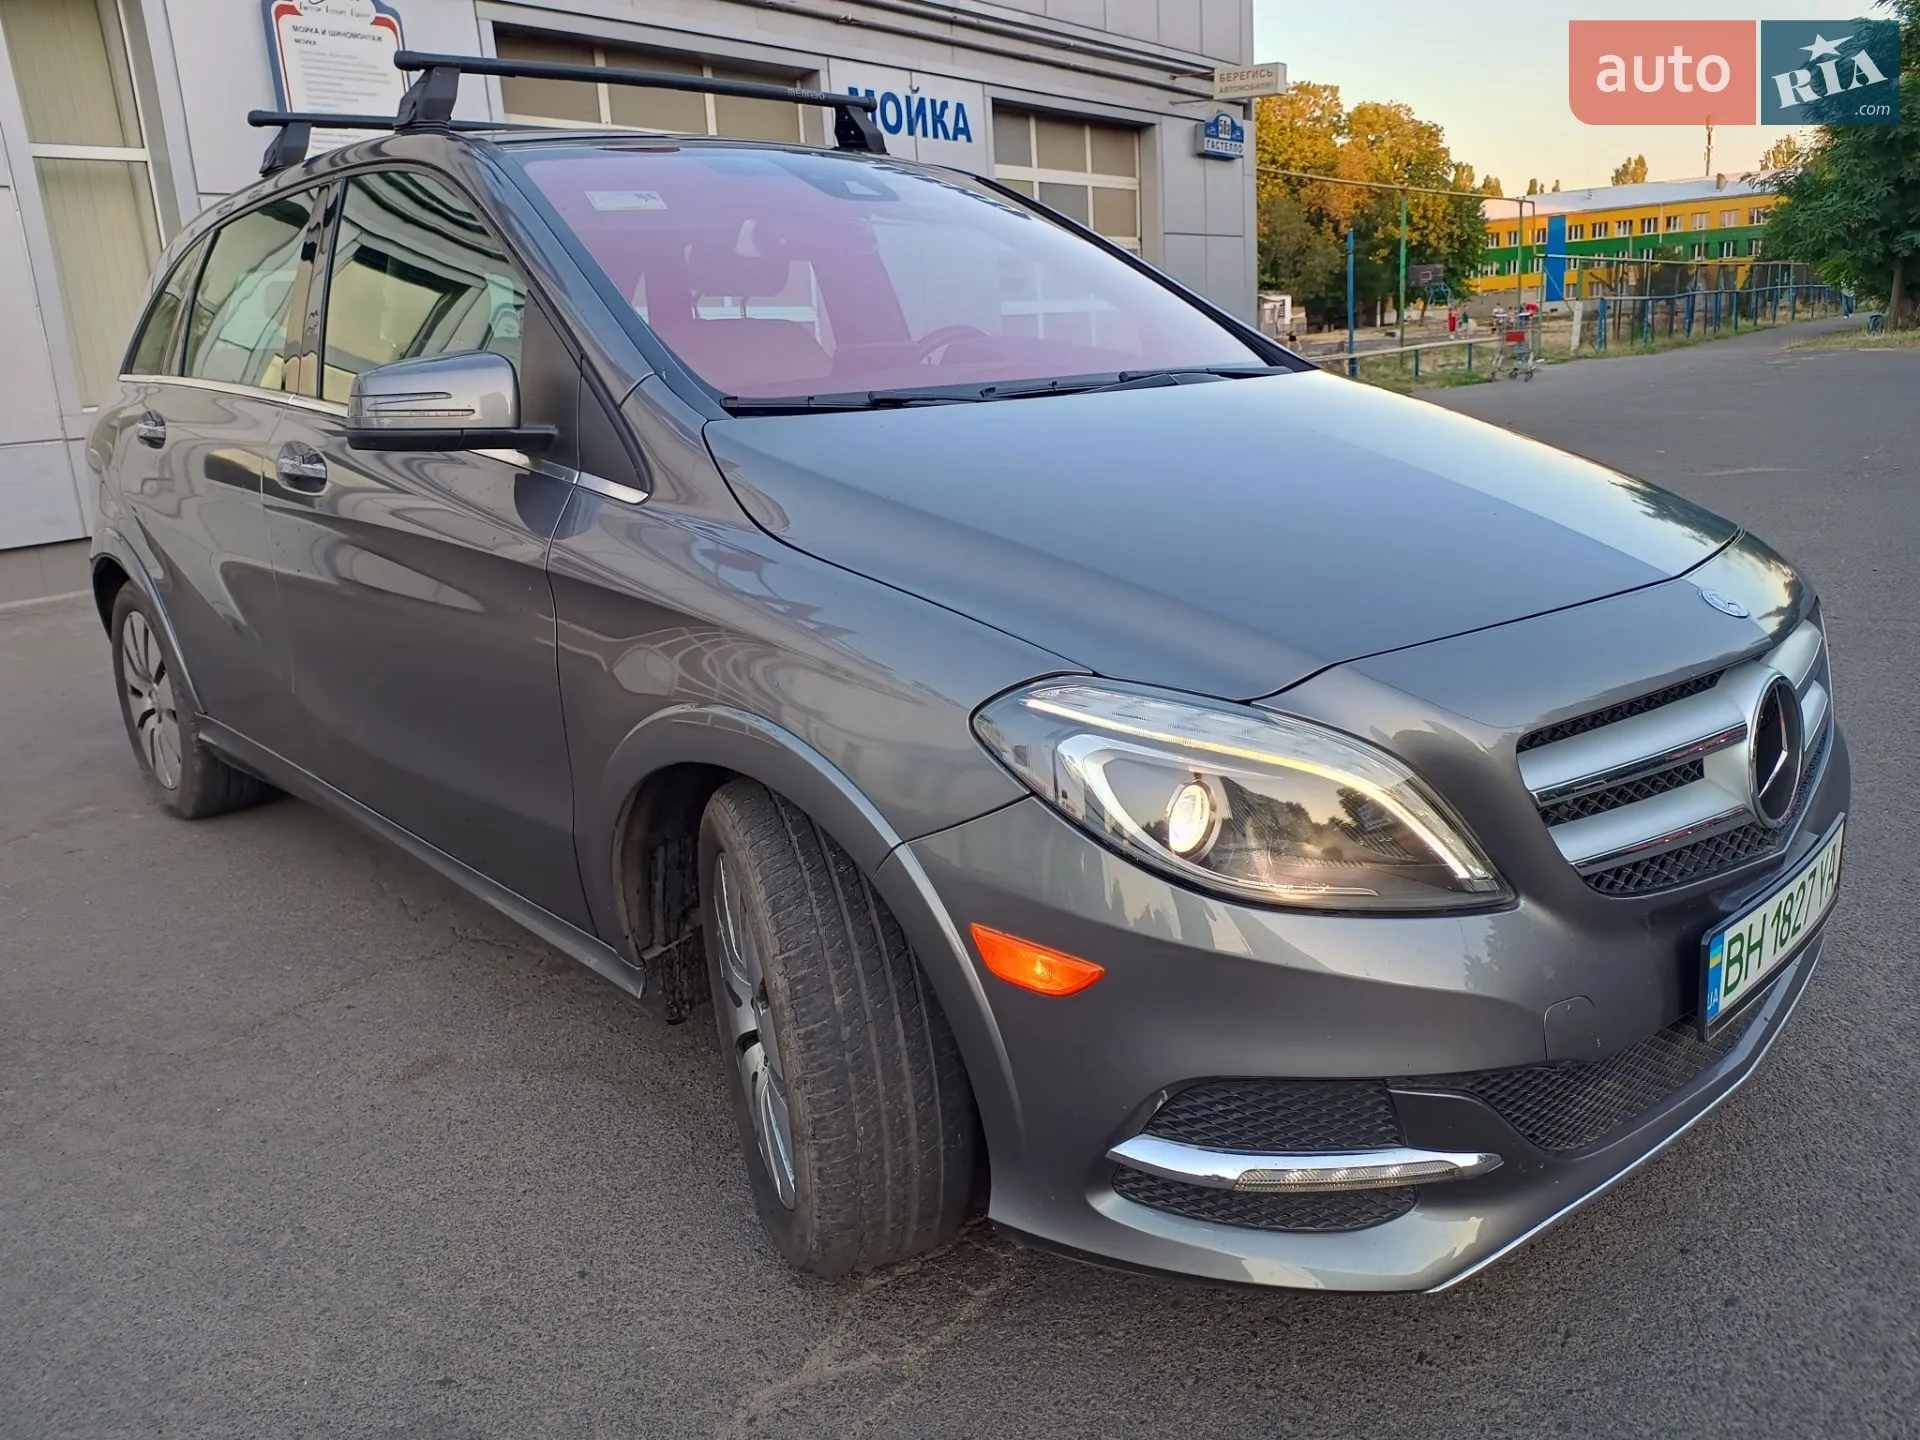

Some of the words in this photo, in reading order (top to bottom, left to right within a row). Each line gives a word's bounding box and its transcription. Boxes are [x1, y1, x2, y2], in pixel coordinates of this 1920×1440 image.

[1219, 68, 1273, 82] БЕРЕГИСЬ
[1206, 139, 1243, 154] ГАСТЕЛЛО
[1723, 913, 1767, 998] BH
[1771, 867, 1817, 956] 1827
[1707, 987, 1719, 1010] UA
